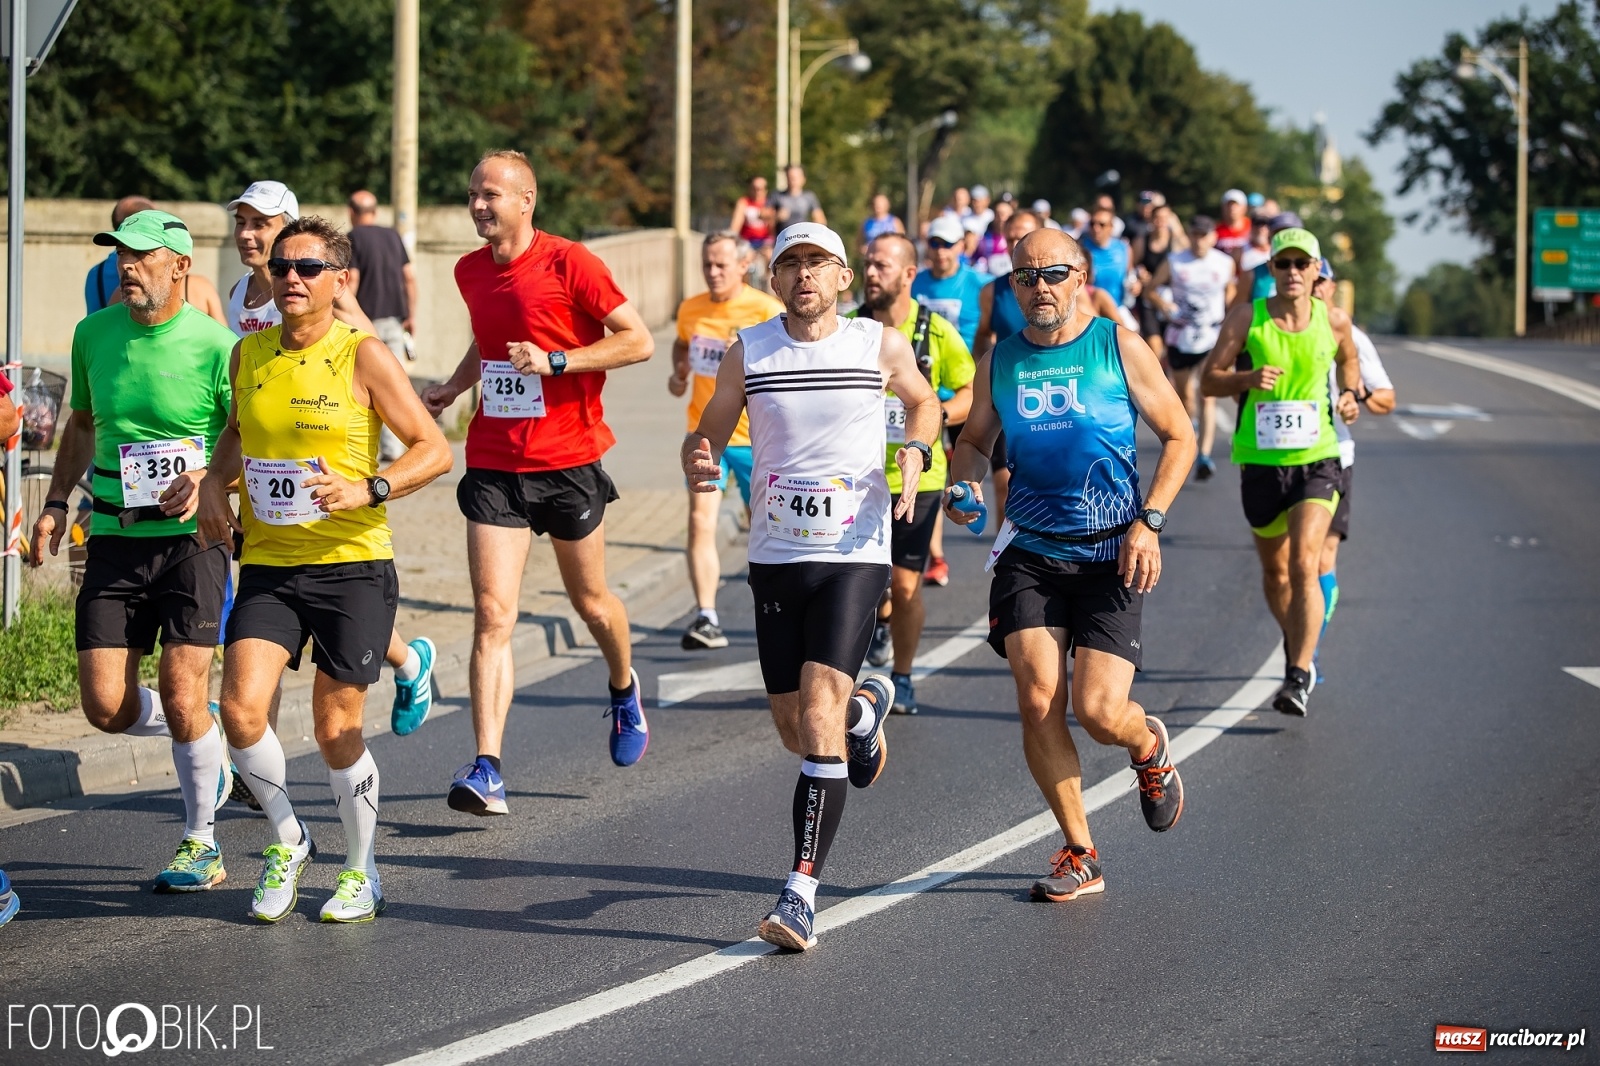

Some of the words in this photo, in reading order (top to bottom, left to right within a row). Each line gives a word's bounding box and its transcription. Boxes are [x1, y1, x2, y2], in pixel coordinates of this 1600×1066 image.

[495, 377, 525, 395] 236
[290, 394, 339, 410] OchajoRun
[1016, 378, 1086, 419] bbl
[295, 421, 330, 431] Sławek
[1030, 420, 1074, 432] RACIBÓRZ
[1274, 414, 1302, 429] 351
[147, 455, 187, 479] 330
[268, 477, 295, 499] 20
[789, 494, 832, 518] 461
